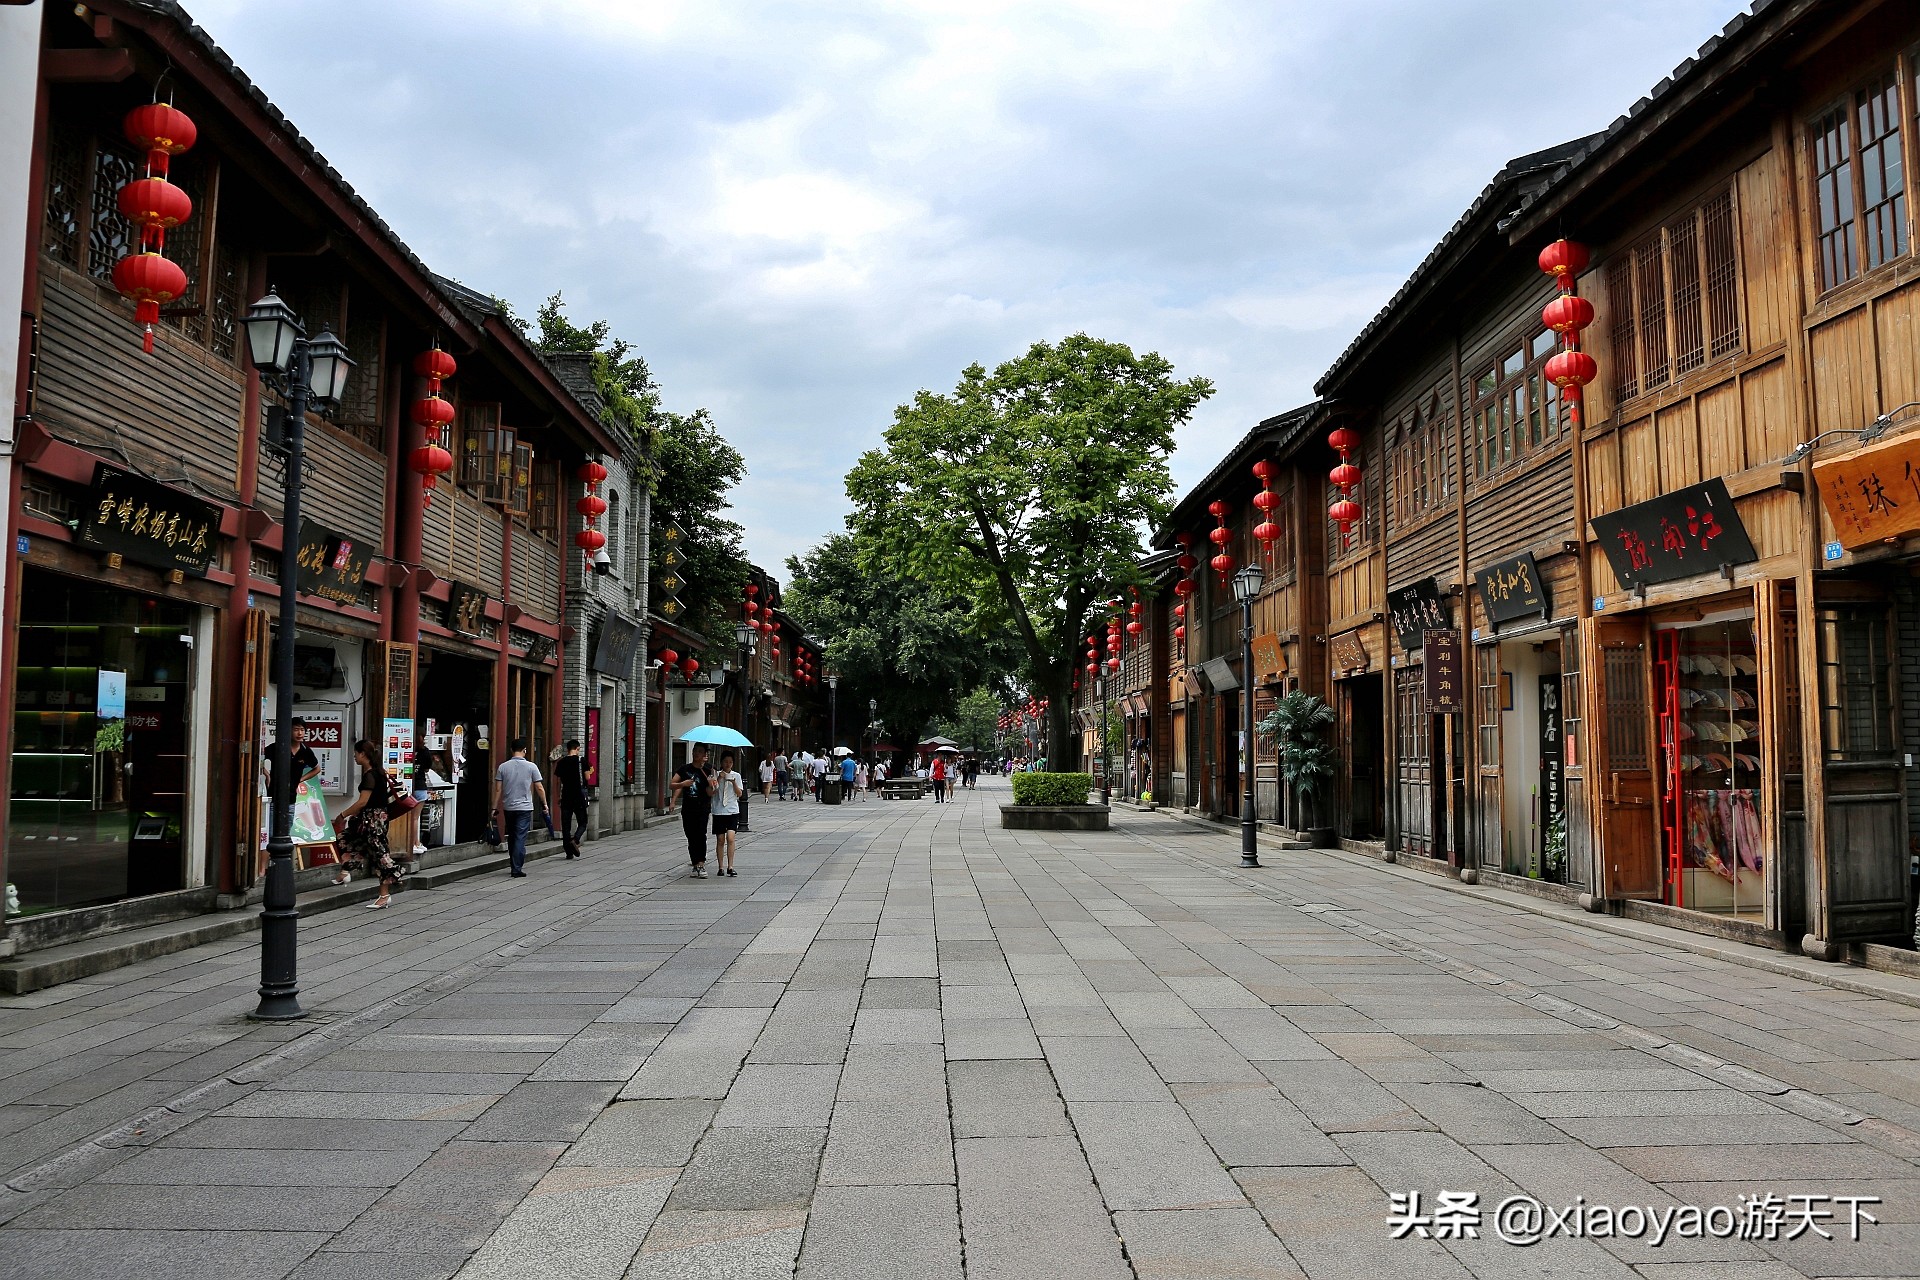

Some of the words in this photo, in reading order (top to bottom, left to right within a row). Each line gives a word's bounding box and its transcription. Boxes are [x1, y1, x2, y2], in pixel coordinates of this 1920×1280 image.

[664, 528, 678, 615] 快乐柠檬
[1437, 636, 1452, 705] 宝利牛角梳
